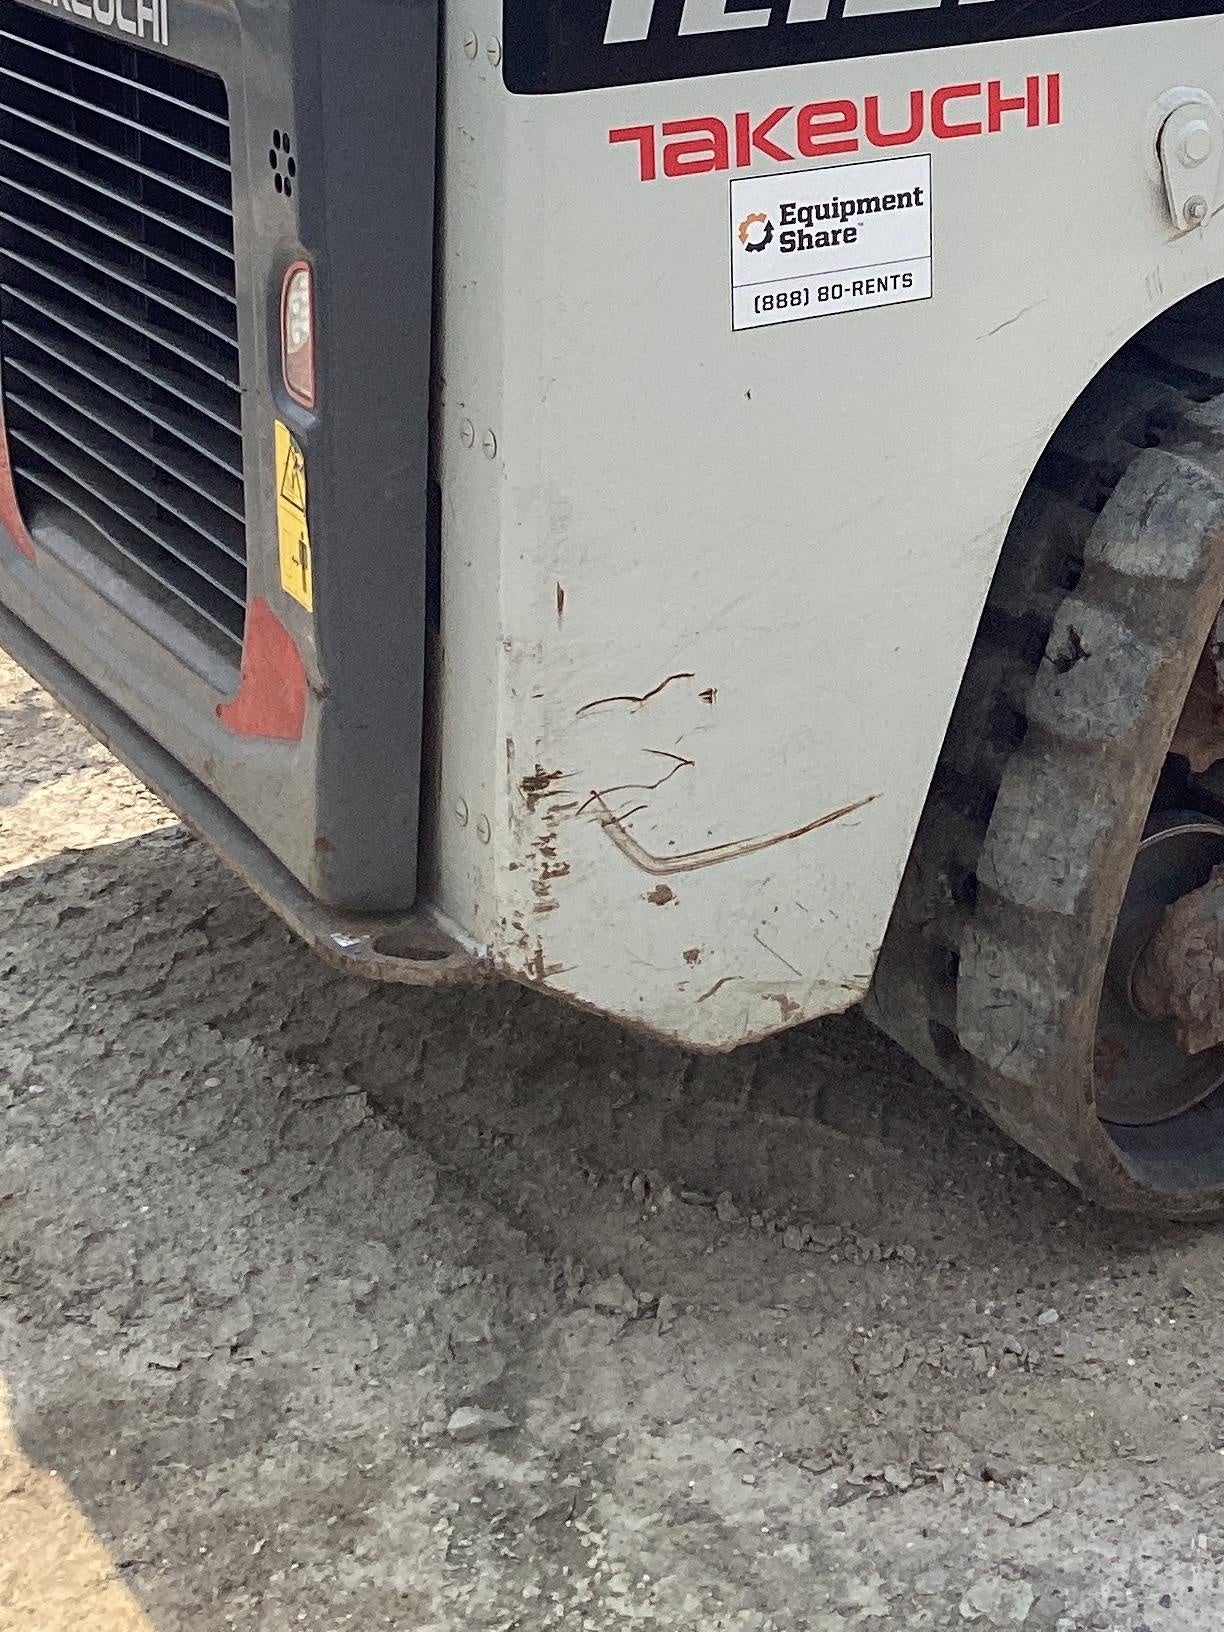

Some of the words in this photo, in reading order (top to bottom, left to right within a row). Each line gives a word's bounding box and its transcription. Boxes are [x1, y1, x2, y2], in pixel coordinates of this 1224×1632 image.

[779, 186, 925, 227] Equipment
[779, 225, 858, 253] Share
[754, 286, 810, 314] (888)
[817, 272, 914, 303] 80-RENTS
